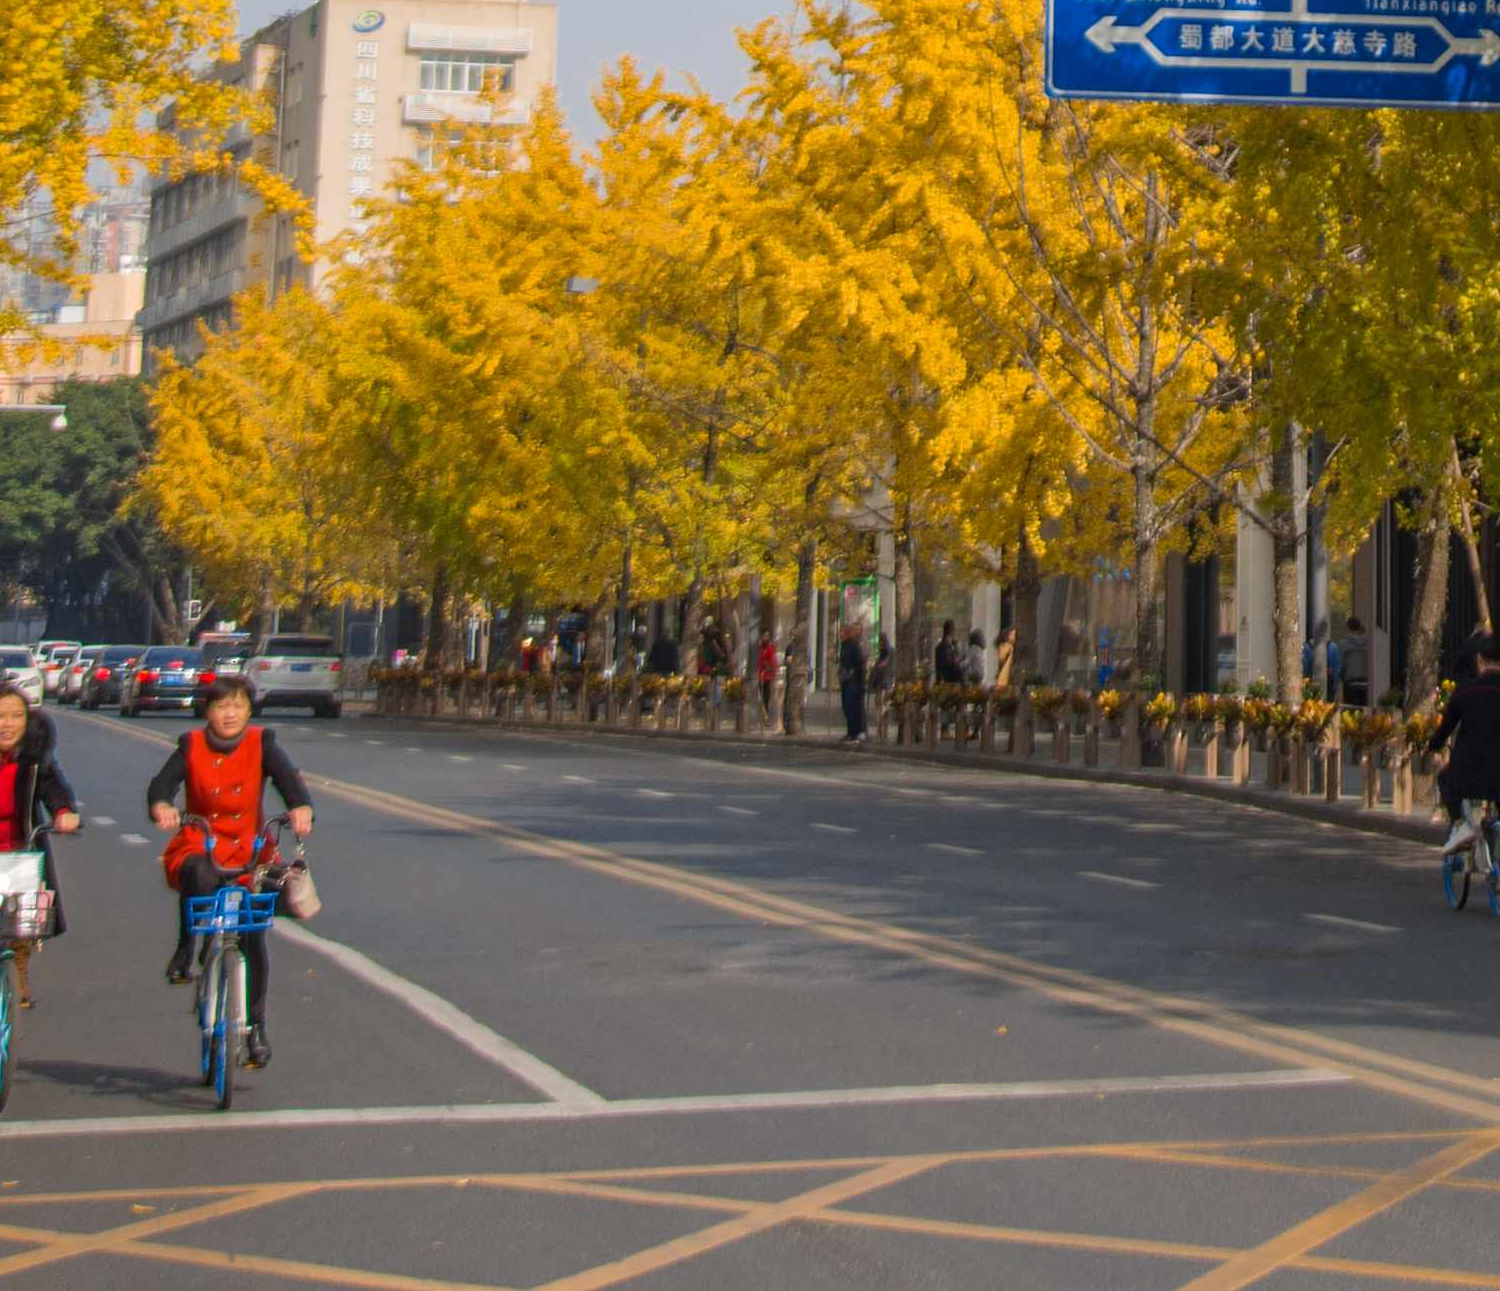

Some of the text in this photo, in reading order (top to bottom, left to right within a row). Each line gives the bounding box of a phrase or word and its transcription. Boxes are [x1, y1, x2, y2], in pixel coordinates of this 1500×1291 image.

[1179, 23, 1419, 58] 蜀都大道大慈寺路
